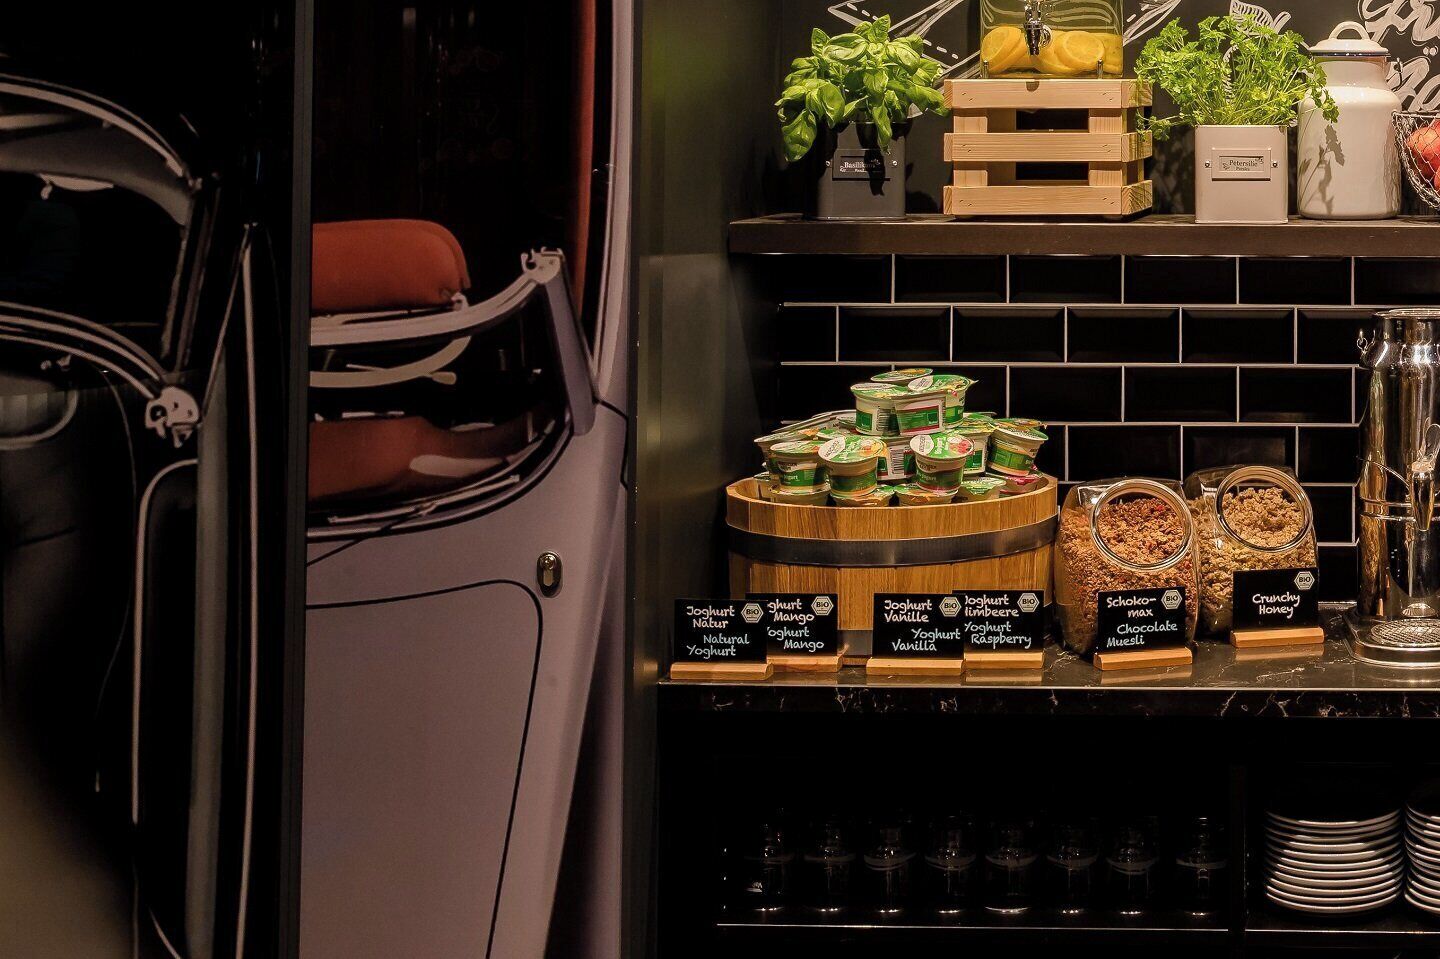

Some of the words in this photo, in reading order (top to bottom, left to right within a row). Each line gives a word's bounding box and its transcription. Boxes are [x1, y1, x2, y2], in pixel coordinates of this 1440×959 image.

[767, 599, 802, 613] ghurt
[1106, 594, 1157, 608] Schoko-
[1252, 591, 1301, 607] Crunchy
[686, 605, 735, 620] Joghurt
[884, 600, 932, 614] Joghurt
[1128, 607, 1154, 618] max
[1259, 604, 1294, 619] Honey
[693, 618, 729, 628] Natur
[774, 612, 815, 625] Mango
[884, 610, 929, 623] Vanille
[964, 621, 1012, 634] Yoghurt
[1117, 620, 1178, 635] Chocolate
[703, 634, 750, 644] Natural
[911, 628, 961, 642] Yoghurt
[971, 633, 1032, 649] Raspberry
[1106, 634, 1145, 647] Muesli
[686, 644, 736, 659] Yoghurt
[783, 639, 825, 652] Mango
[892, 639, 937, 651] Vanilla
